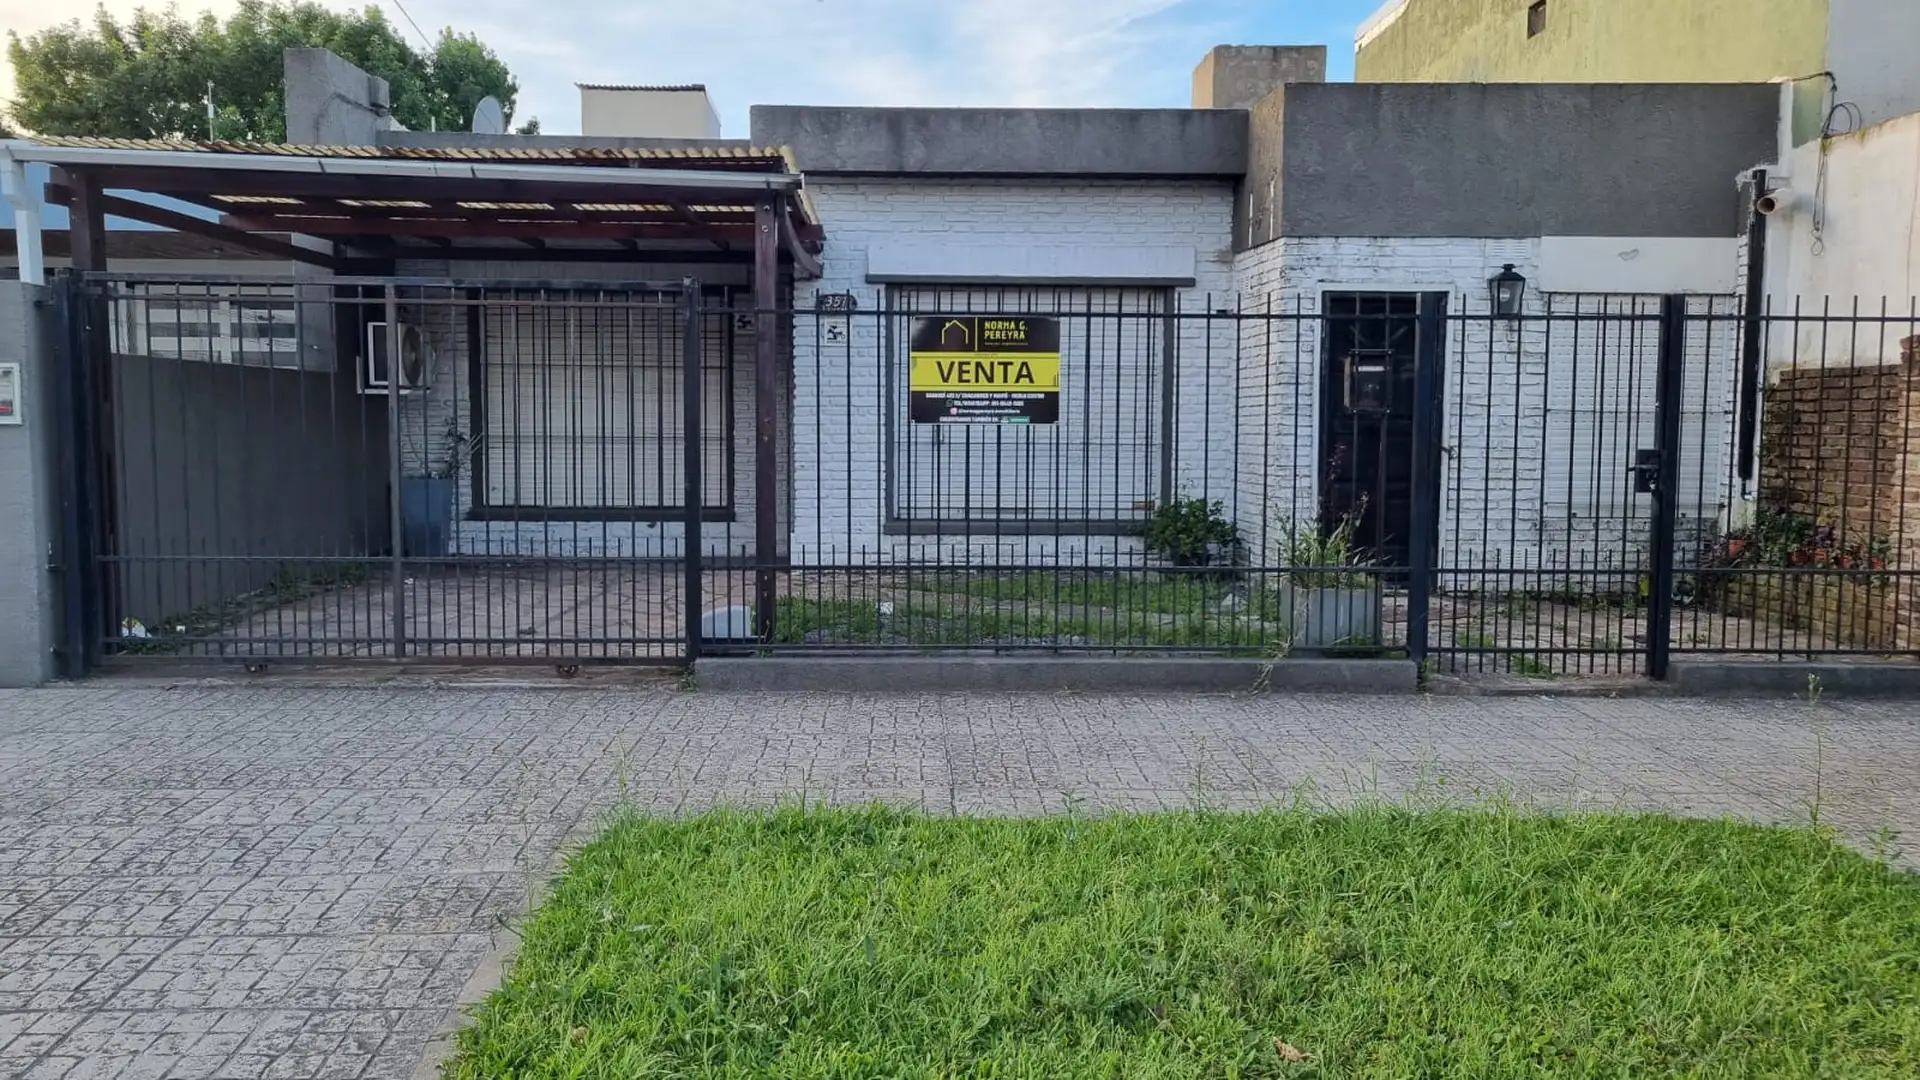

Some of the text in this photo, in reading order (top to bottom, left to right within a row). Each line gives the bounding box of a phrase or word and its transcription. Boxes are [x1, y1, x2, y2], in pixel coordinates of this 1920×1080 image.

[984, 320, 1016, 330] NORMA
[984, 330, 1025, 340] PEREYRA
[936, 360, 1035, 384] VENTA
